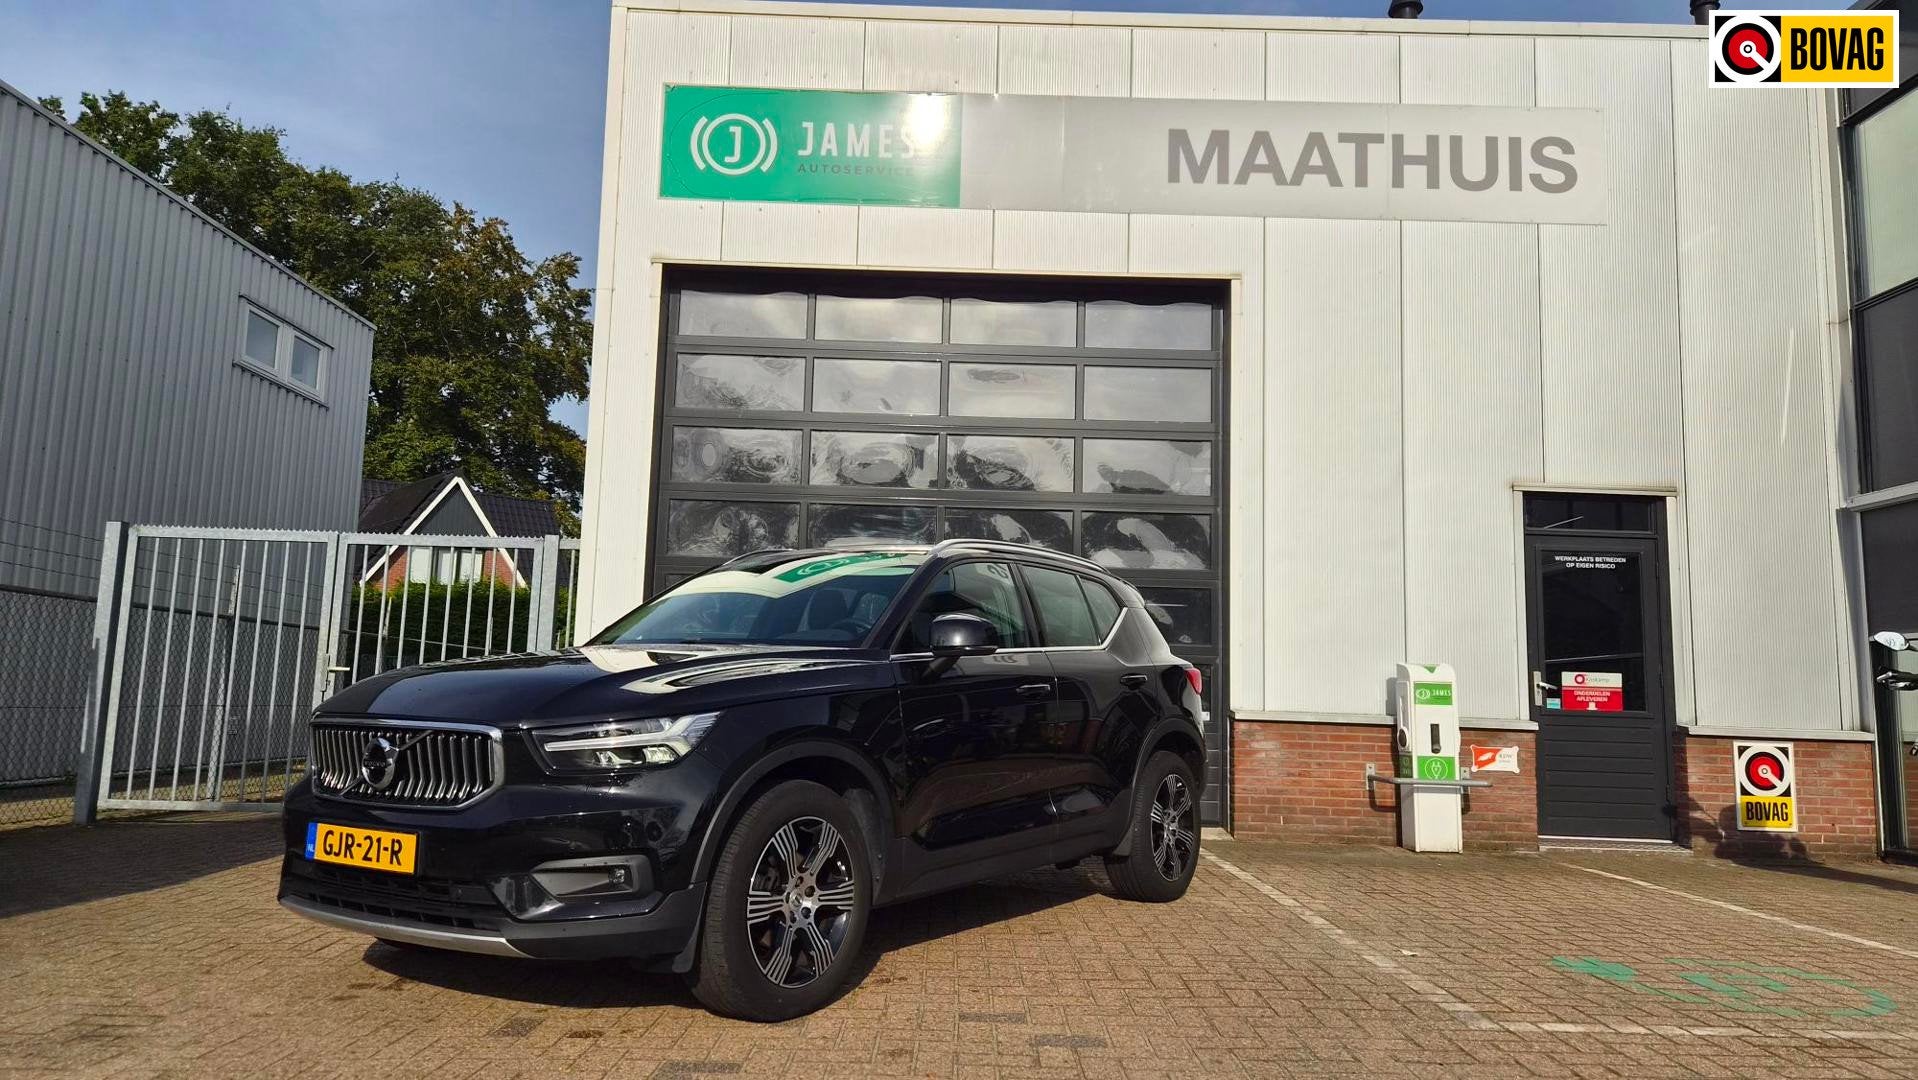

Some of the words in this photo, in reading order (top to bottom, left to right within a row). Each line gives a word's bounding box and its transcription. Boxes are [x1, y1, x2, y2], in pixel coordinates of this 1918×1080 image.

[724, 126, 741, 163] J
[797, 121, 917, 159] JAMES
[797, 163, 915, 177] AUTOSERVICE
[1167, 127, 1579, 194] MAATHUIS
[1745, 801, 1789, 822] BOVAG
[322, 829, 403, 867] GJR-21-R
